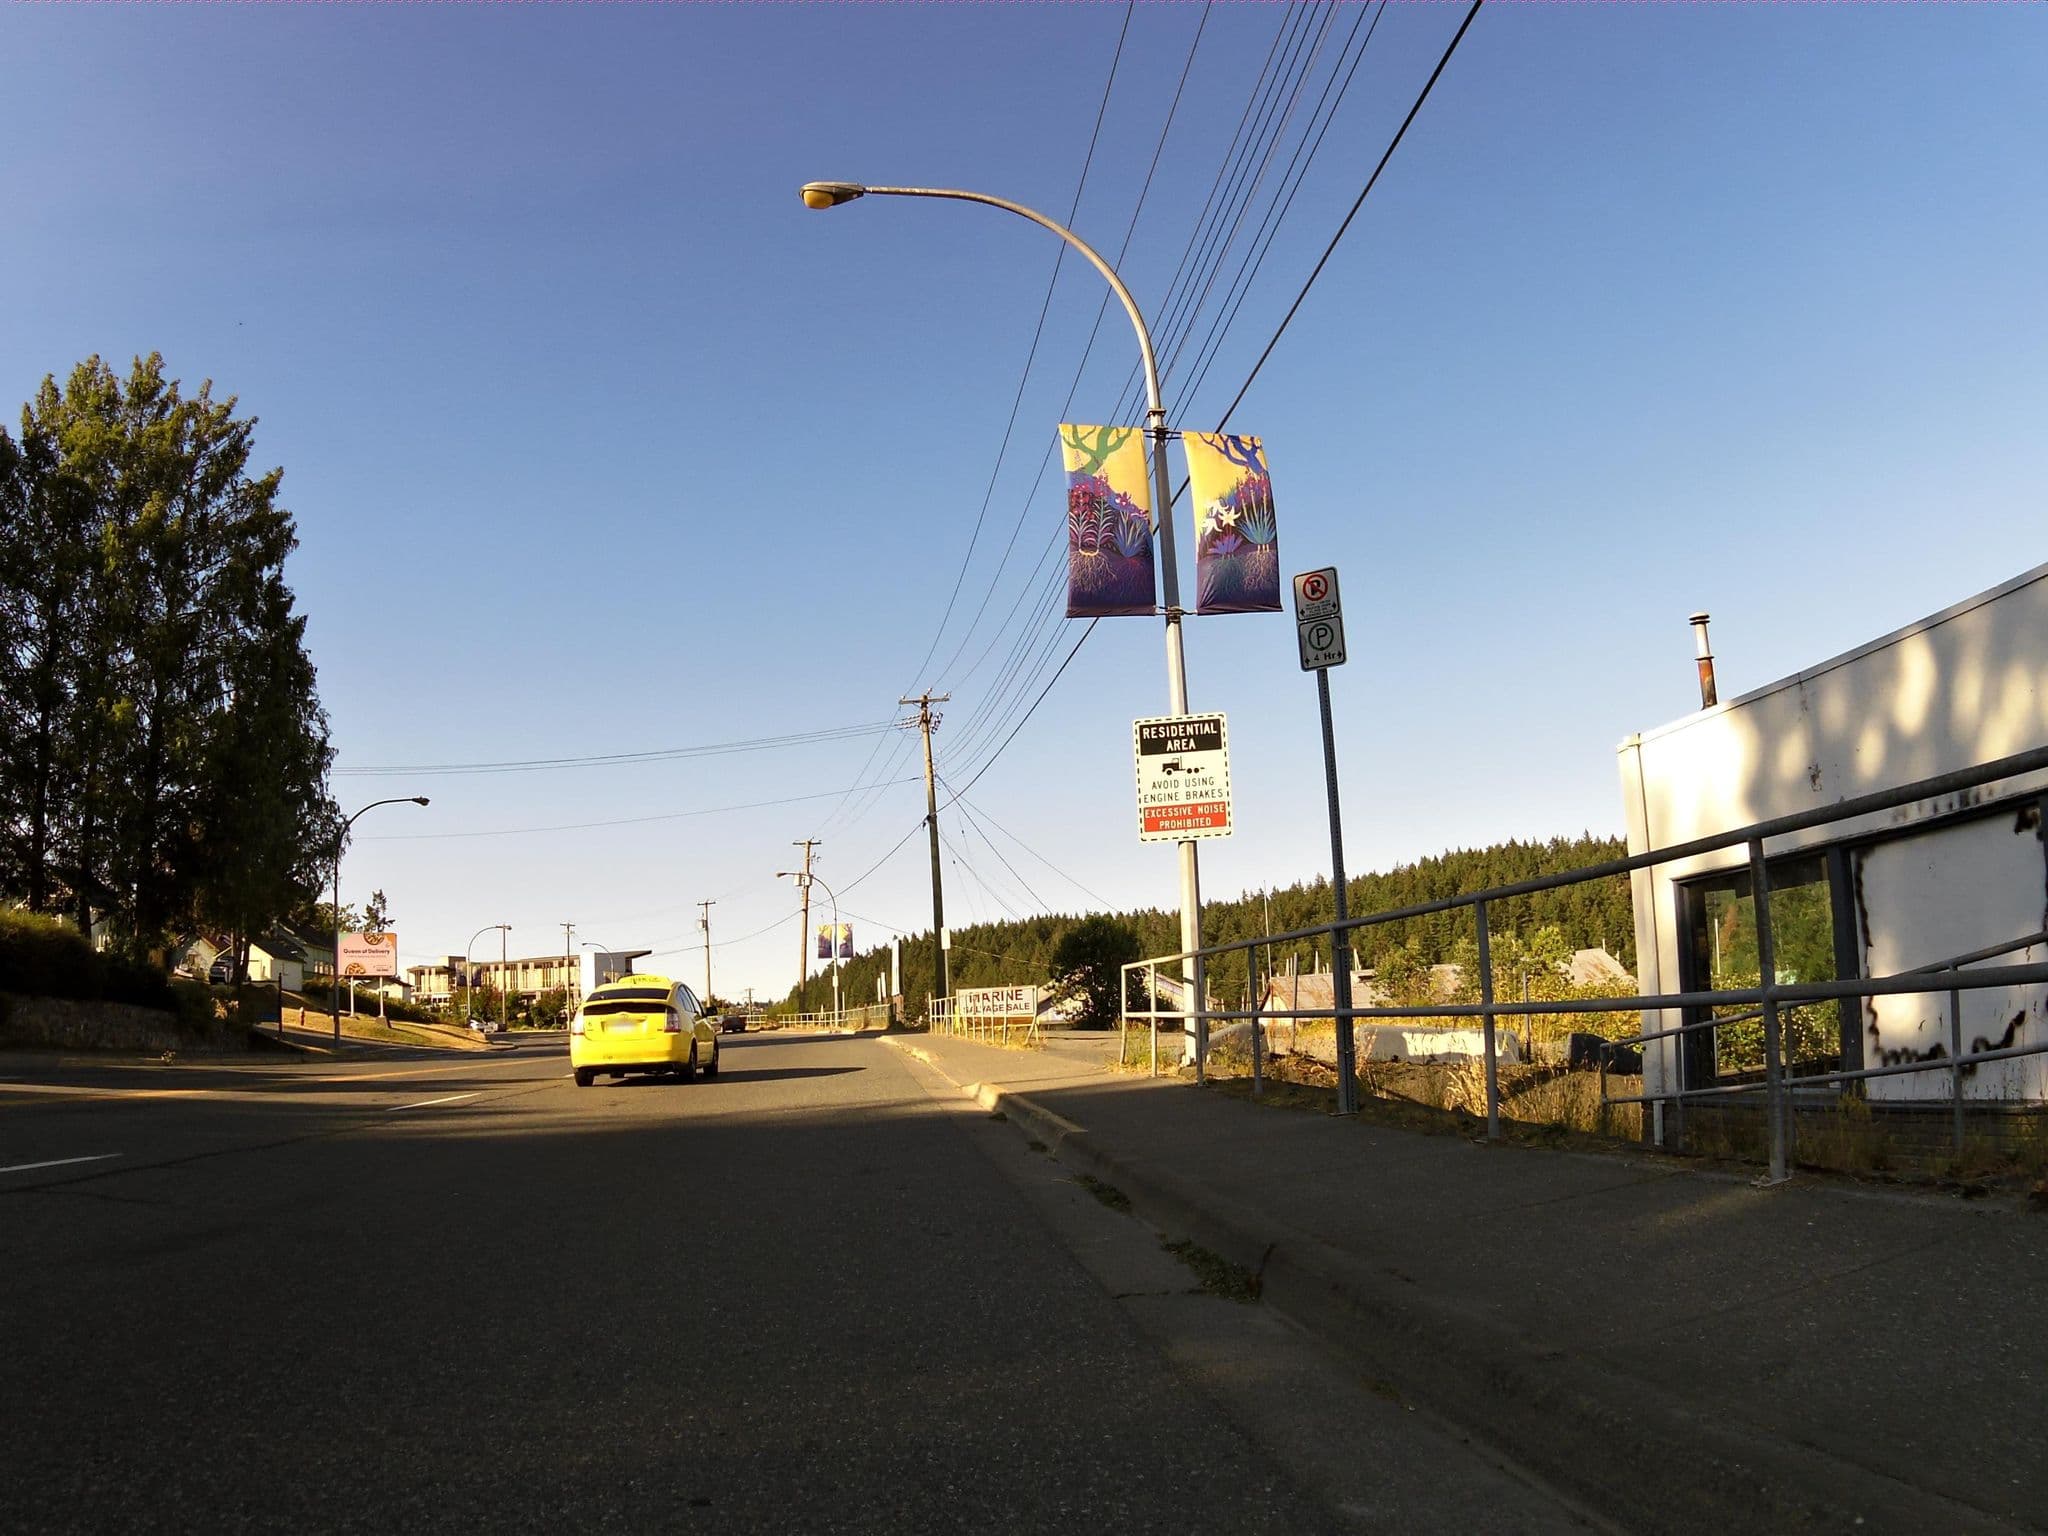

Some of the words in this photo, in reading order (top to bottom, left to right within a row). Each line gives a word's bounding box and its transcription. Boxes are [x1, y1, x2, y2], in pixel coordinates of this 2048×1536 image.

[1314, 653, 1320, 661] 4
[1324, 651, 1335, 661] Hr
[1142, 723, 1217, 739] RESIDENTIAL
[1166, 739, 1196, 752] AREA
[1151, 780, 1180, 790] AVOID
[1185, 776, 1215, 788] USING
[1144, 792, 1179, 804] ENGINE
[1185, 789, 1224, 800] BRAKES
[1144, 806, 1193, 819] EXCESSIVE
[1197, 803, 1225, 814] NOISE
[1159, 817, 1212, 830] PROHIBITED
[969, 989, 1024, 1003] MARINE
[1006, 1002, 1030, 1012] SALE
